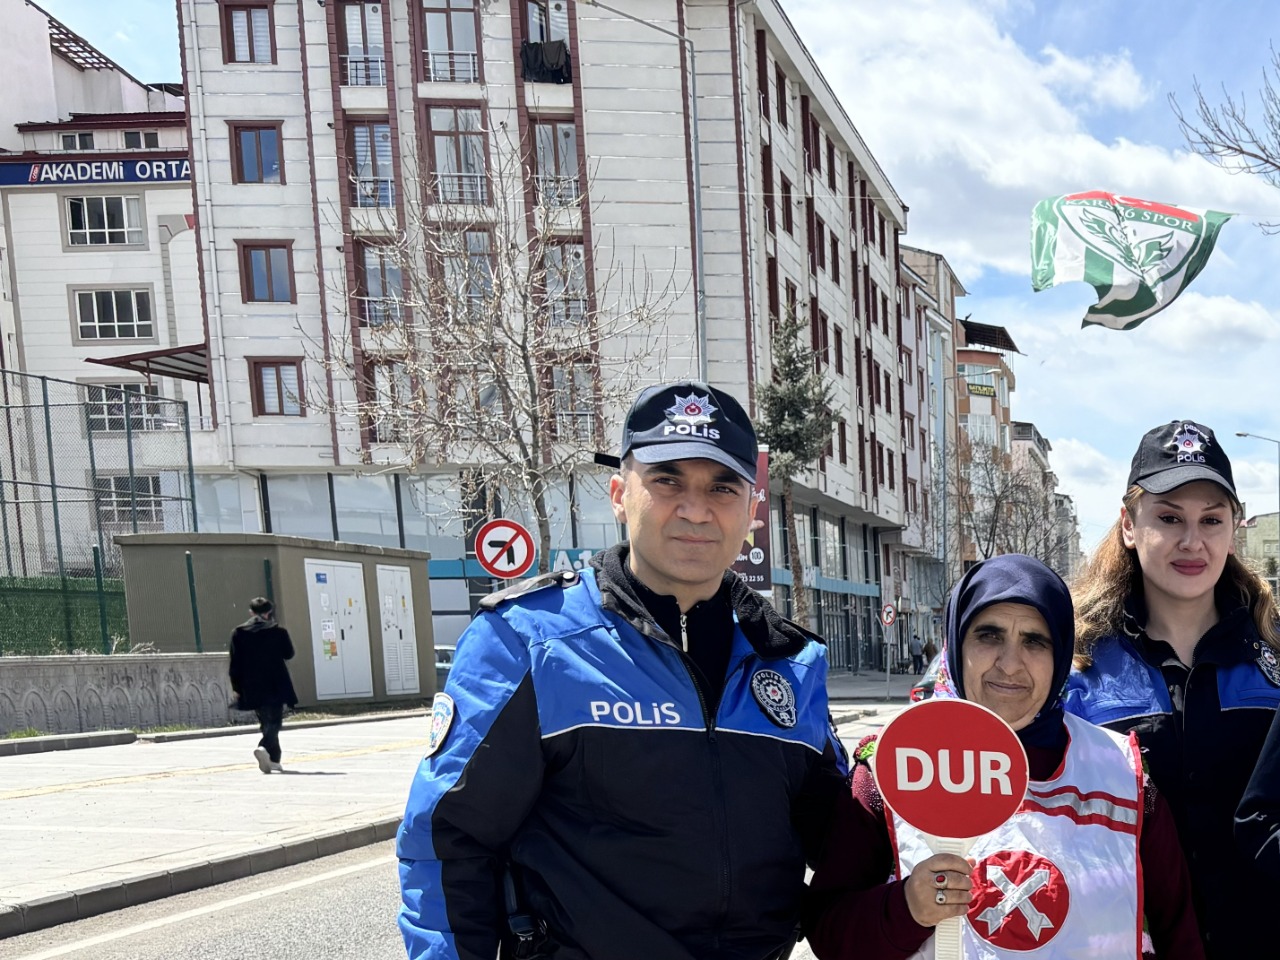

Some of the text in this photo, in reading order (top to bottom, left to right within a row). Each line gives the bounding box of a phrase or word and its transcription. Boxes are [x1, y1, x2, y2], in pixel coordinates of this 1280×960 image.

[1141, 210, 1194, 232] SPOR
[663, 424, 721, 440] POLİS
[1177, 454, 1206, 463] POLİS
[590, 701, 681, 725] POLİS
[895, 747, 1013, 796] DUR
